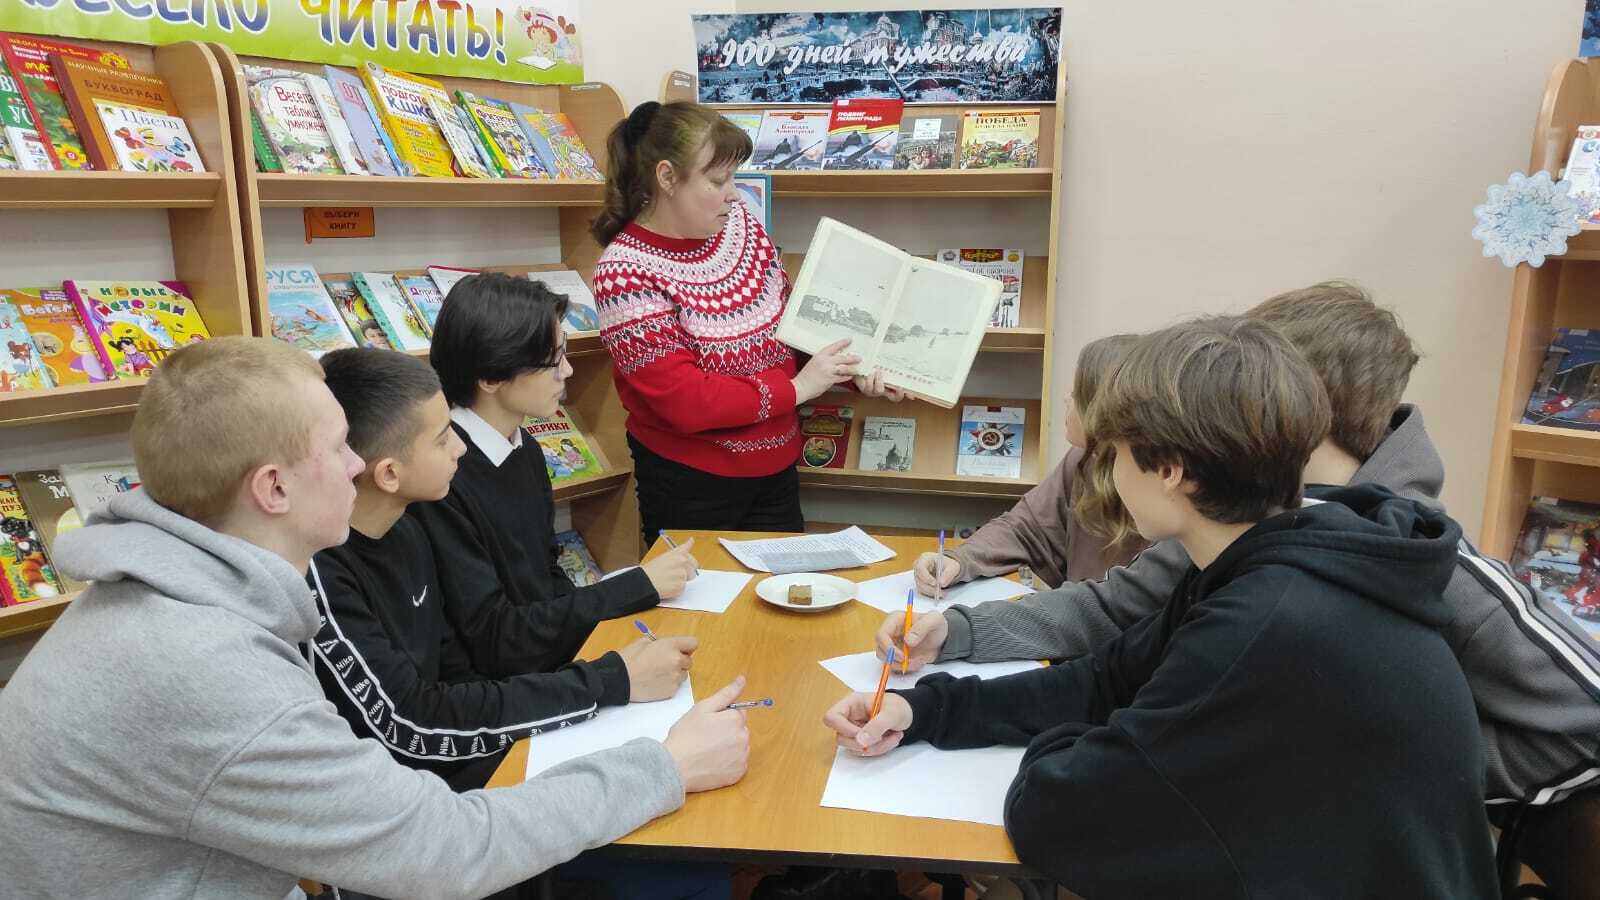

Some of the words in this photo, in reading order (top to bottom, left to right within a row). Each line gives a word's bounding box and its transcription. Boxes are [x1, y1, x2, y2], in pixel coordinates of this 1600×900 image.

[302, 0, 505, 64] ЧИТАТЬ!
[719, 38, 776, 68] 900
[784, 39, 852, 75] дней
[83, 79, 164, 103] БУКВОГРАД
[976, 116, 1026, 125] ПОБЕДА
[324, 210, 360, 219] ВЫБЕРИ
[329, 222, 357, 230] КНИГУ
[99, 286, 168, 298] НОВЫЕ
[96, 299, 186, 317] ИСТОРИИ
[335, 655, 353, 671] Nike
[351, 678, 371, 696] Nike
[368, 699, 384, 718] Nike
[408, 734, 420, 753] Nike
[439, 736, 449, 755] Nike
